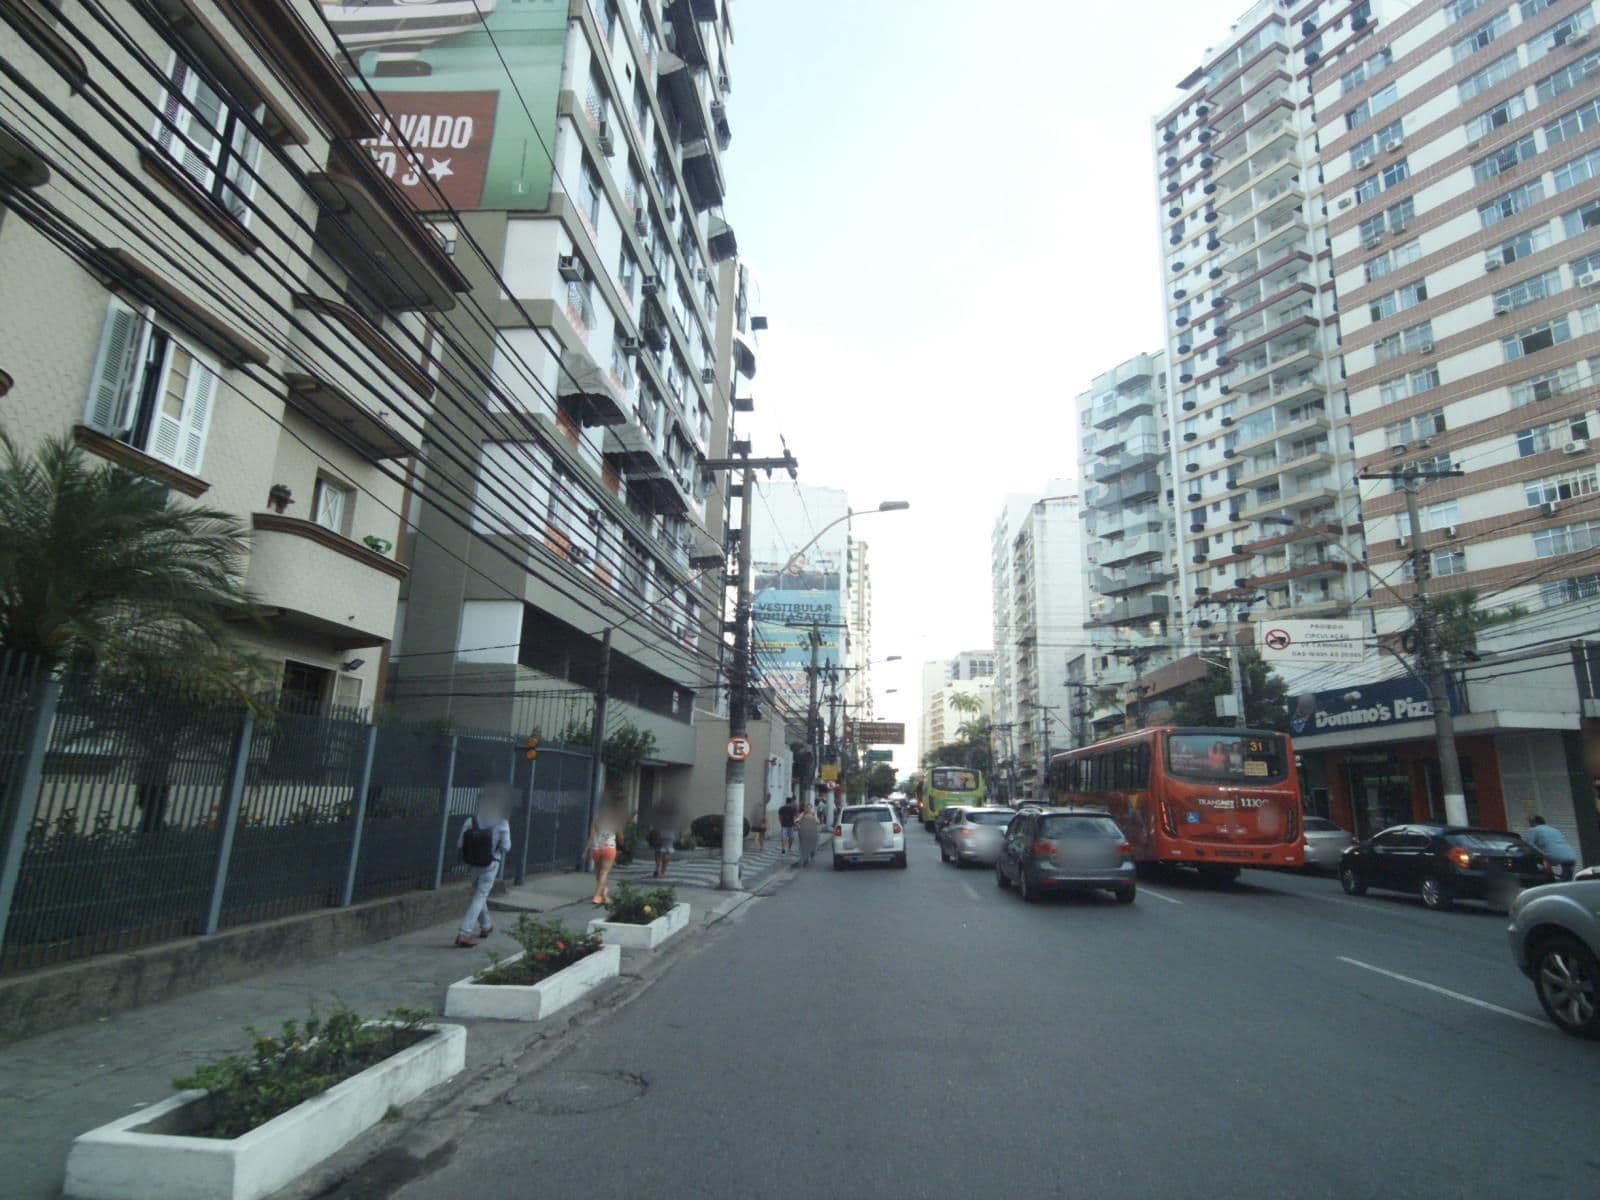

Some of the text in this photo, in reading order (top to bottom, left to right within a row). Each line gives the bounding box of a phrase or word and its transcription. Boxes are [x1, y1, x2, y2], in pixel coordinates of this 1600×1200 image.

[758, 603, 832, 612] VESTIBULAR
[1315, 697, 1436, 728] Domino's Pizz
[1249, 741, 1263, 752] 31
